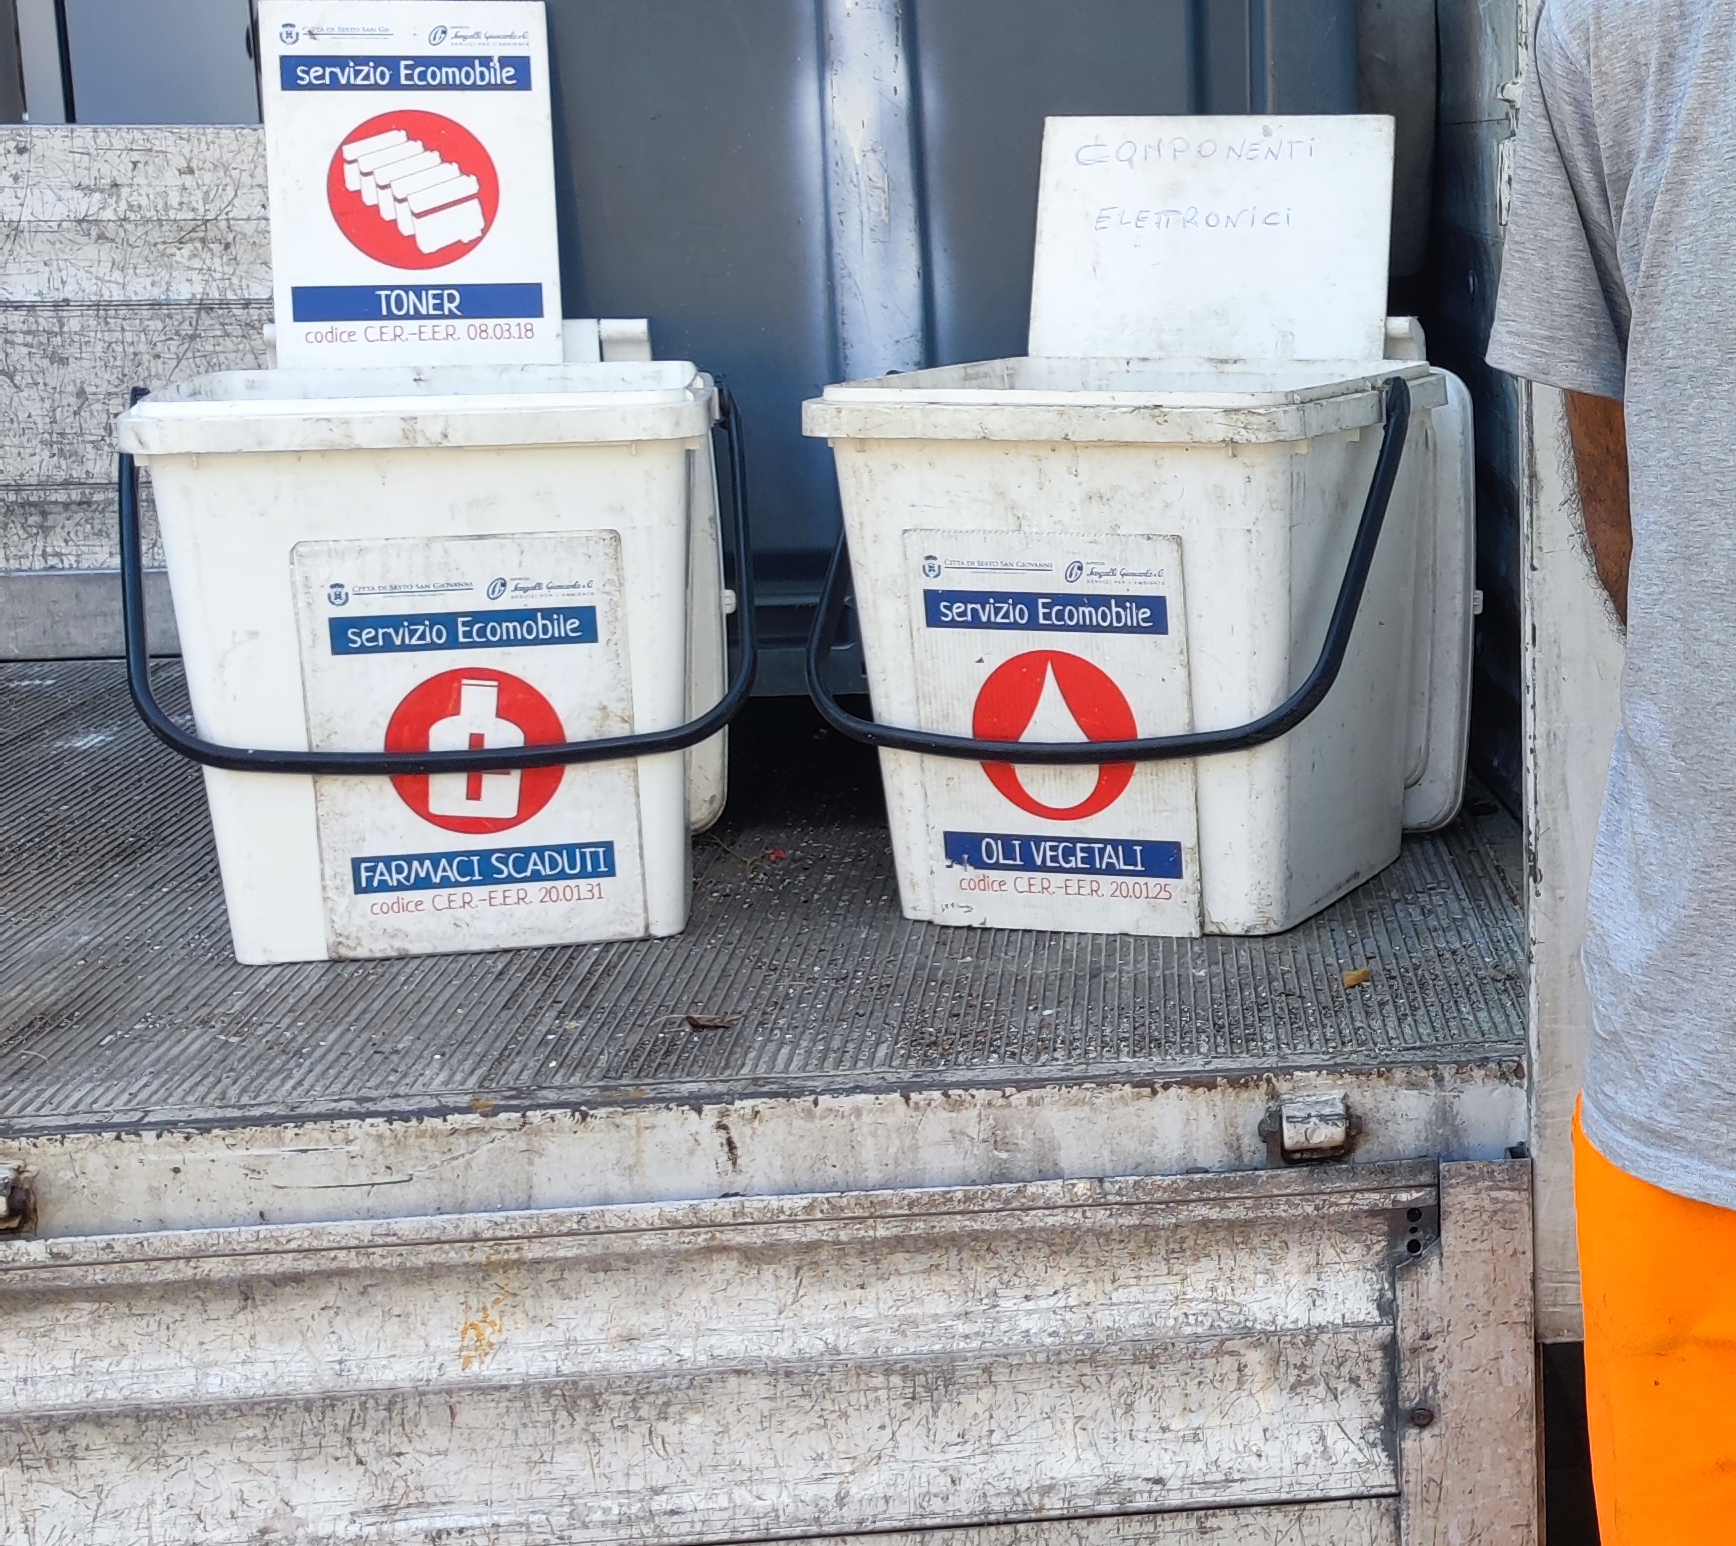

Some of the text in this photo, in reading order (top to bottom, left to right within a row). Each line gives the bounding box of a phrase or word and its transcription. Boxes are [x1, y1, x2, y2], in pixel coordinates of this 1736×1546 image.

[296, 58, 517, 86] servizio Ecomobile
[374, 289, 463, 316] TONER
[305, 322, 535, 344] codice C.E.R.-E.E.R. 08.03.18
[940, 597, 1153, 627] servizio Ecomobile
[347, 612, 583, 648] servizio Ecomobile
[360, 847, 609, 888] FARMACI SCADUTI
[981, 837, 1145, 871] OLI VEGETALI
[959, 873, 1008, 892] codice
[370, 896, 426, 916] codice
